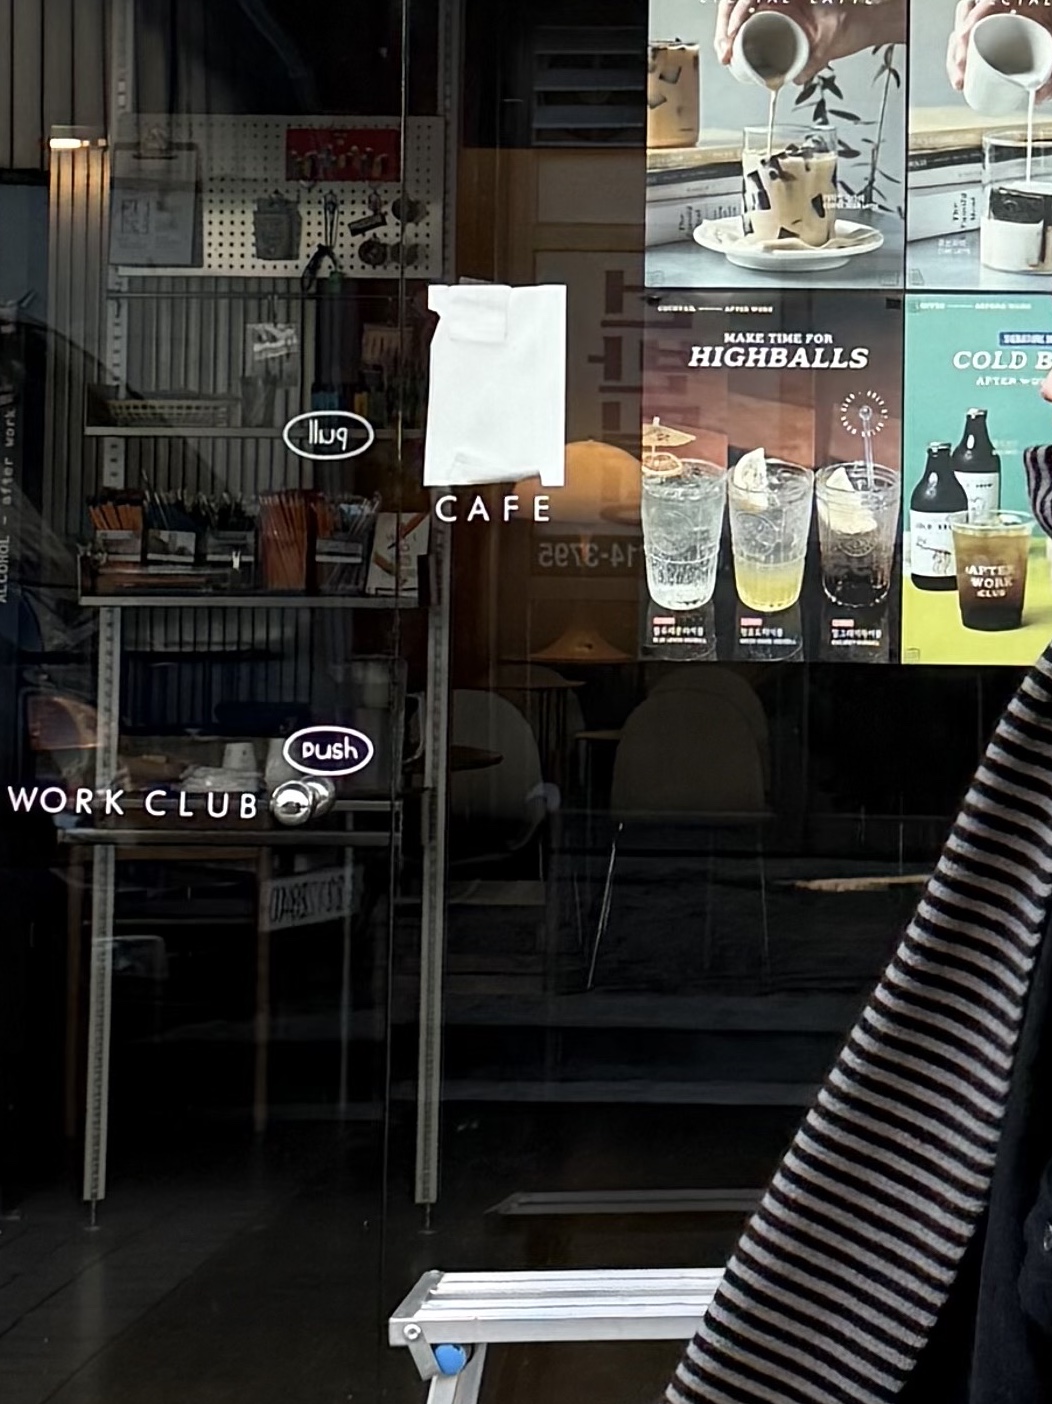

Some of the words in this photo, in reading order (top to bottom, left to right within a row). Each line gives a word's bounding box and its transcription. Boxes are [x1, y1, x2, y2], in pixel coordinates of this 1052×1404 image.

[724, 333, 764, 343] MAKE
[768, 333, 802, 343] TIME
[805, 333, 833, 344] FOR
[688, 346, 869, 368] HIGHBALLS
[953, 350, 1027, 369] COLD
[976, 376, 1016, 385] AFTER
[4, 408, 16, 447] work
[435, 495, 550, 522] CAFE
[970, 577, 1013, 588] WORK
[7, 786, 124, 816] WORK
[145, 790, 257, 819] CLUB
